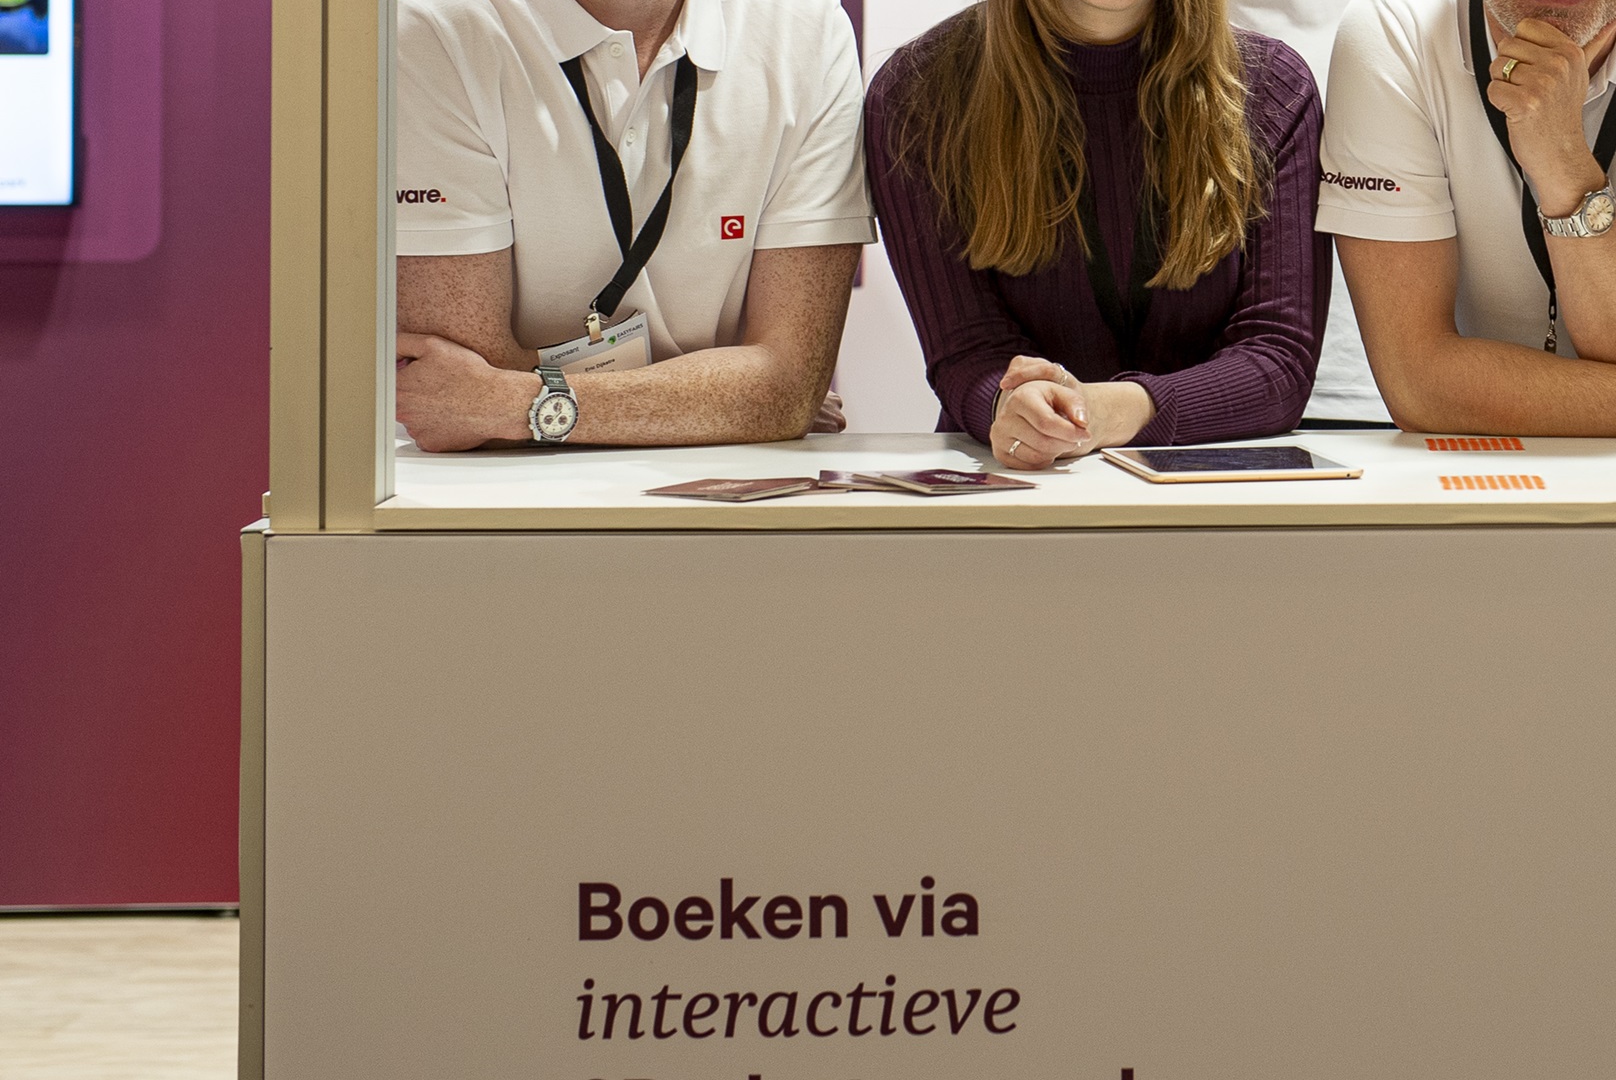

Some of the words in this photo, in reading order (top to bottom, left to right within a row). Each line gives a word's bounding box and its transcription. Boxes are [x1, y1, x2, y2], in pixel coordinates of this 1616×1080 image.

[550, 346, 579, 361] Exposant
[578, 877, 848, 941] Boeken
[873, 875, 979, 938] via
[576, 974, 1020, 1041] interactieve
